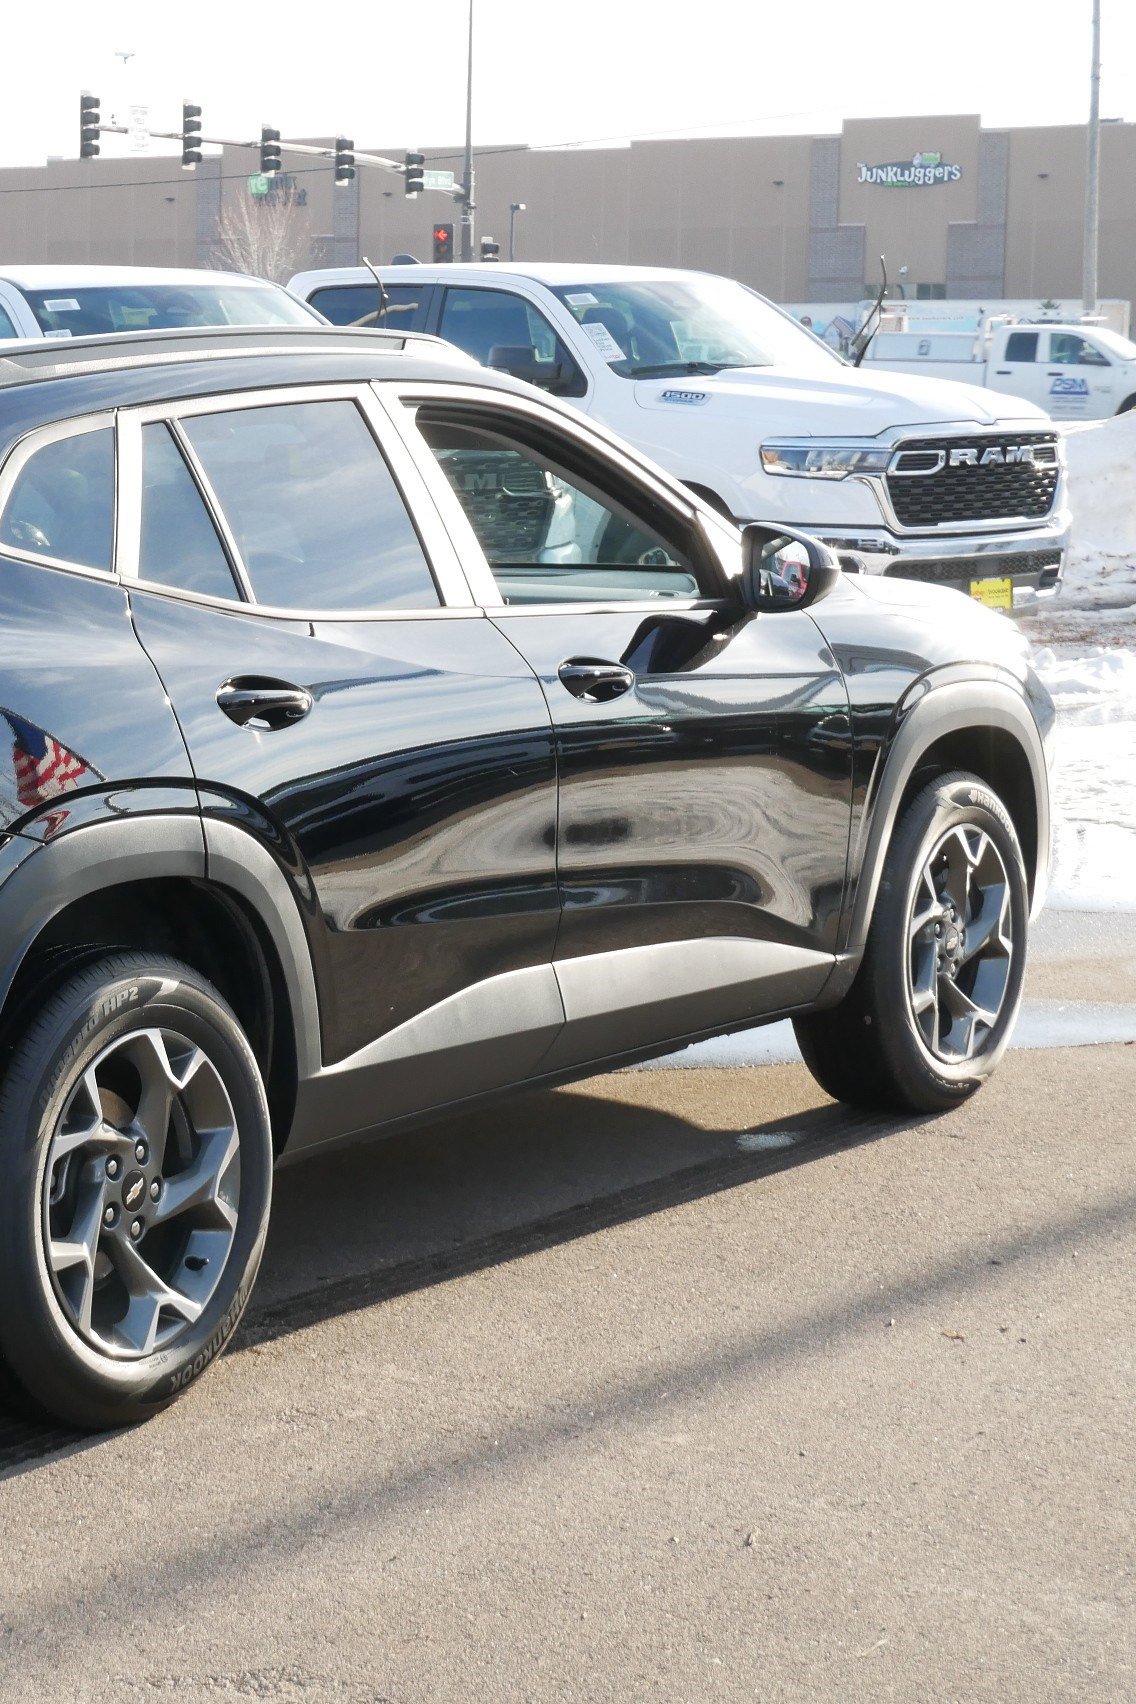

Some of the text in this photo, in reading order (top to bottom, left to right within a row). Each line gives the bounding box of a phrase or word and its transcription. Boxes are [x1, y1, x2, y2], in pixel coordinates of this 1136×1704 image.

[1051, 378, 1087, 391] PSM
[661, 390, 705, 400] 1500
[949, 447, 1033, 466] RAM
[103, 986, 139, 1018] HP2
